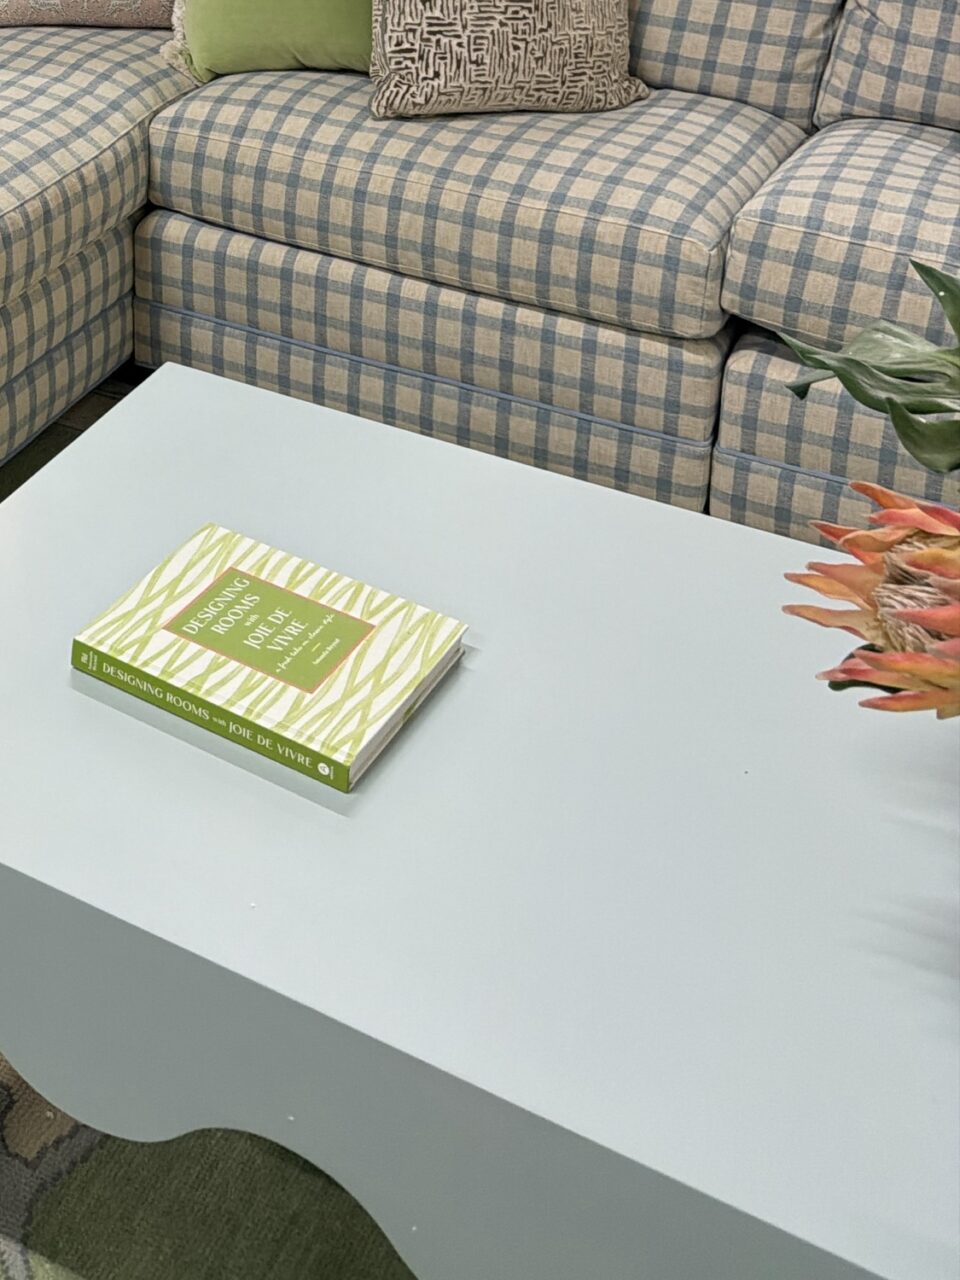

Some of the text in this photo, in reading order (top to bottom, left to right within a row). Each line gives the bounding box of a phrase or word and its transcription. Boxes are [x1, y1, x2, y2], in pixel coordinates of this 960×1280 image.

[182, 577, 249, 634] DESIGNING
[210, 593, 260, 634] ROOMS
[243, 614, 259, 626] with
[242, 606, 292, 649] JOIE DE
[266, 618, 308, 650] VIVRE
[102, 662, 163, 699] DESIGNING
[166, 692, 210, 720] ROOMS
[212, 716, 227, 727] with
[228, 721, 254, 740] JOIE
[256, 734, 273, 750] DE
[276, 743, 313, 768] VIVRE
